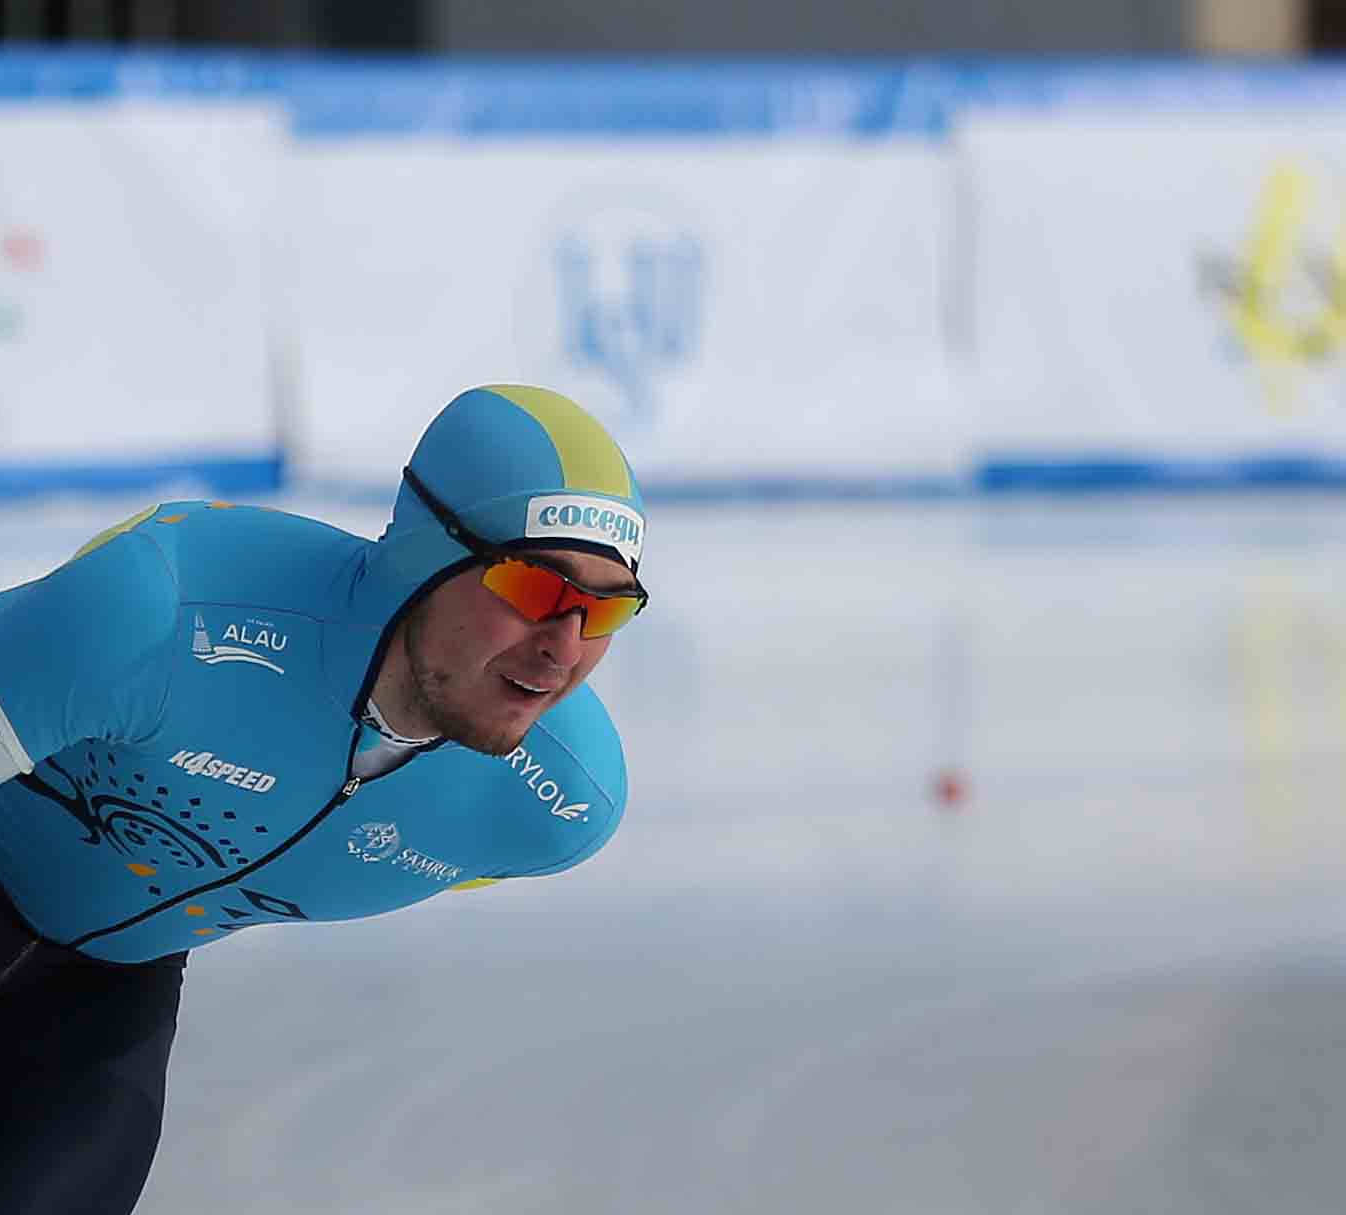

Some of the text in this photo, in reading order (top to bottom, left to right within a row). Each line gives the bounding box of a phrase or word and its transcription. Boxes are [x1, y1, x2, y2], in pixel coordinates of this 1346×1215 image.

[222, 624, 287, 650] ALAU
[168, 750, 277, 793] K4SPEED
[504, 746, 589, 822] RYLOV
